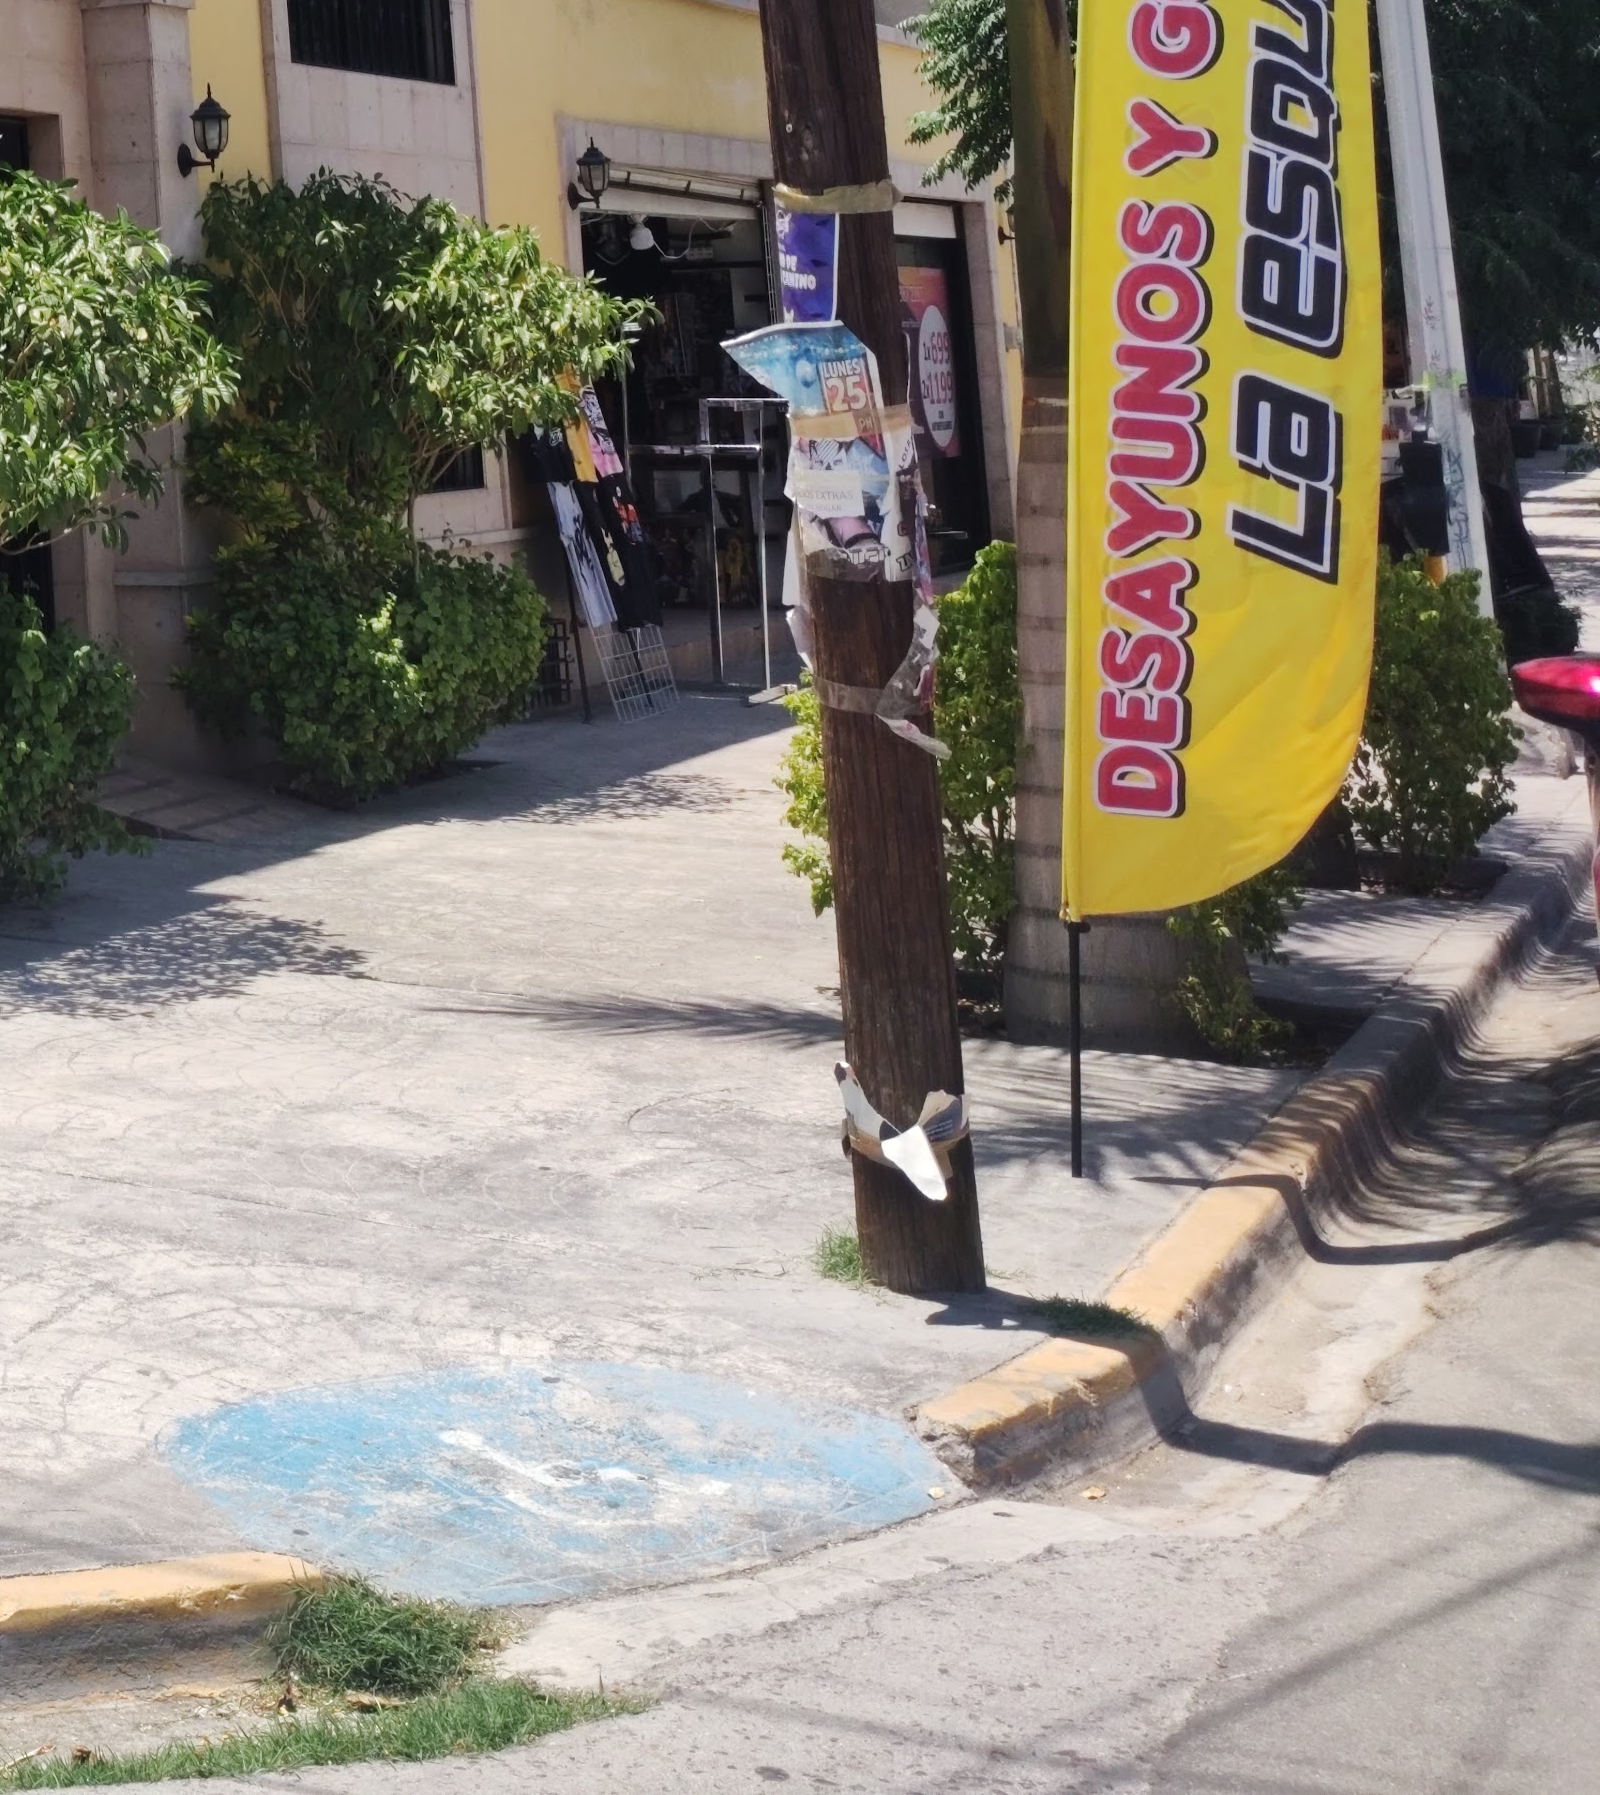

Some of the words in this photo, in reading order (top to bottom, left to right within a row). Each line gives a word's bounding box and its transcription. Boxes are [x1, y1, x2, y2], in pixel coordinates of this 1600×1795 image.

[1124, 97, 1218, 176] Y
[822, 359, 861, 378] LUNES
[826, 375, 868, 412] 25
[1089, 198, 1214, 819] DESAYUNOS
